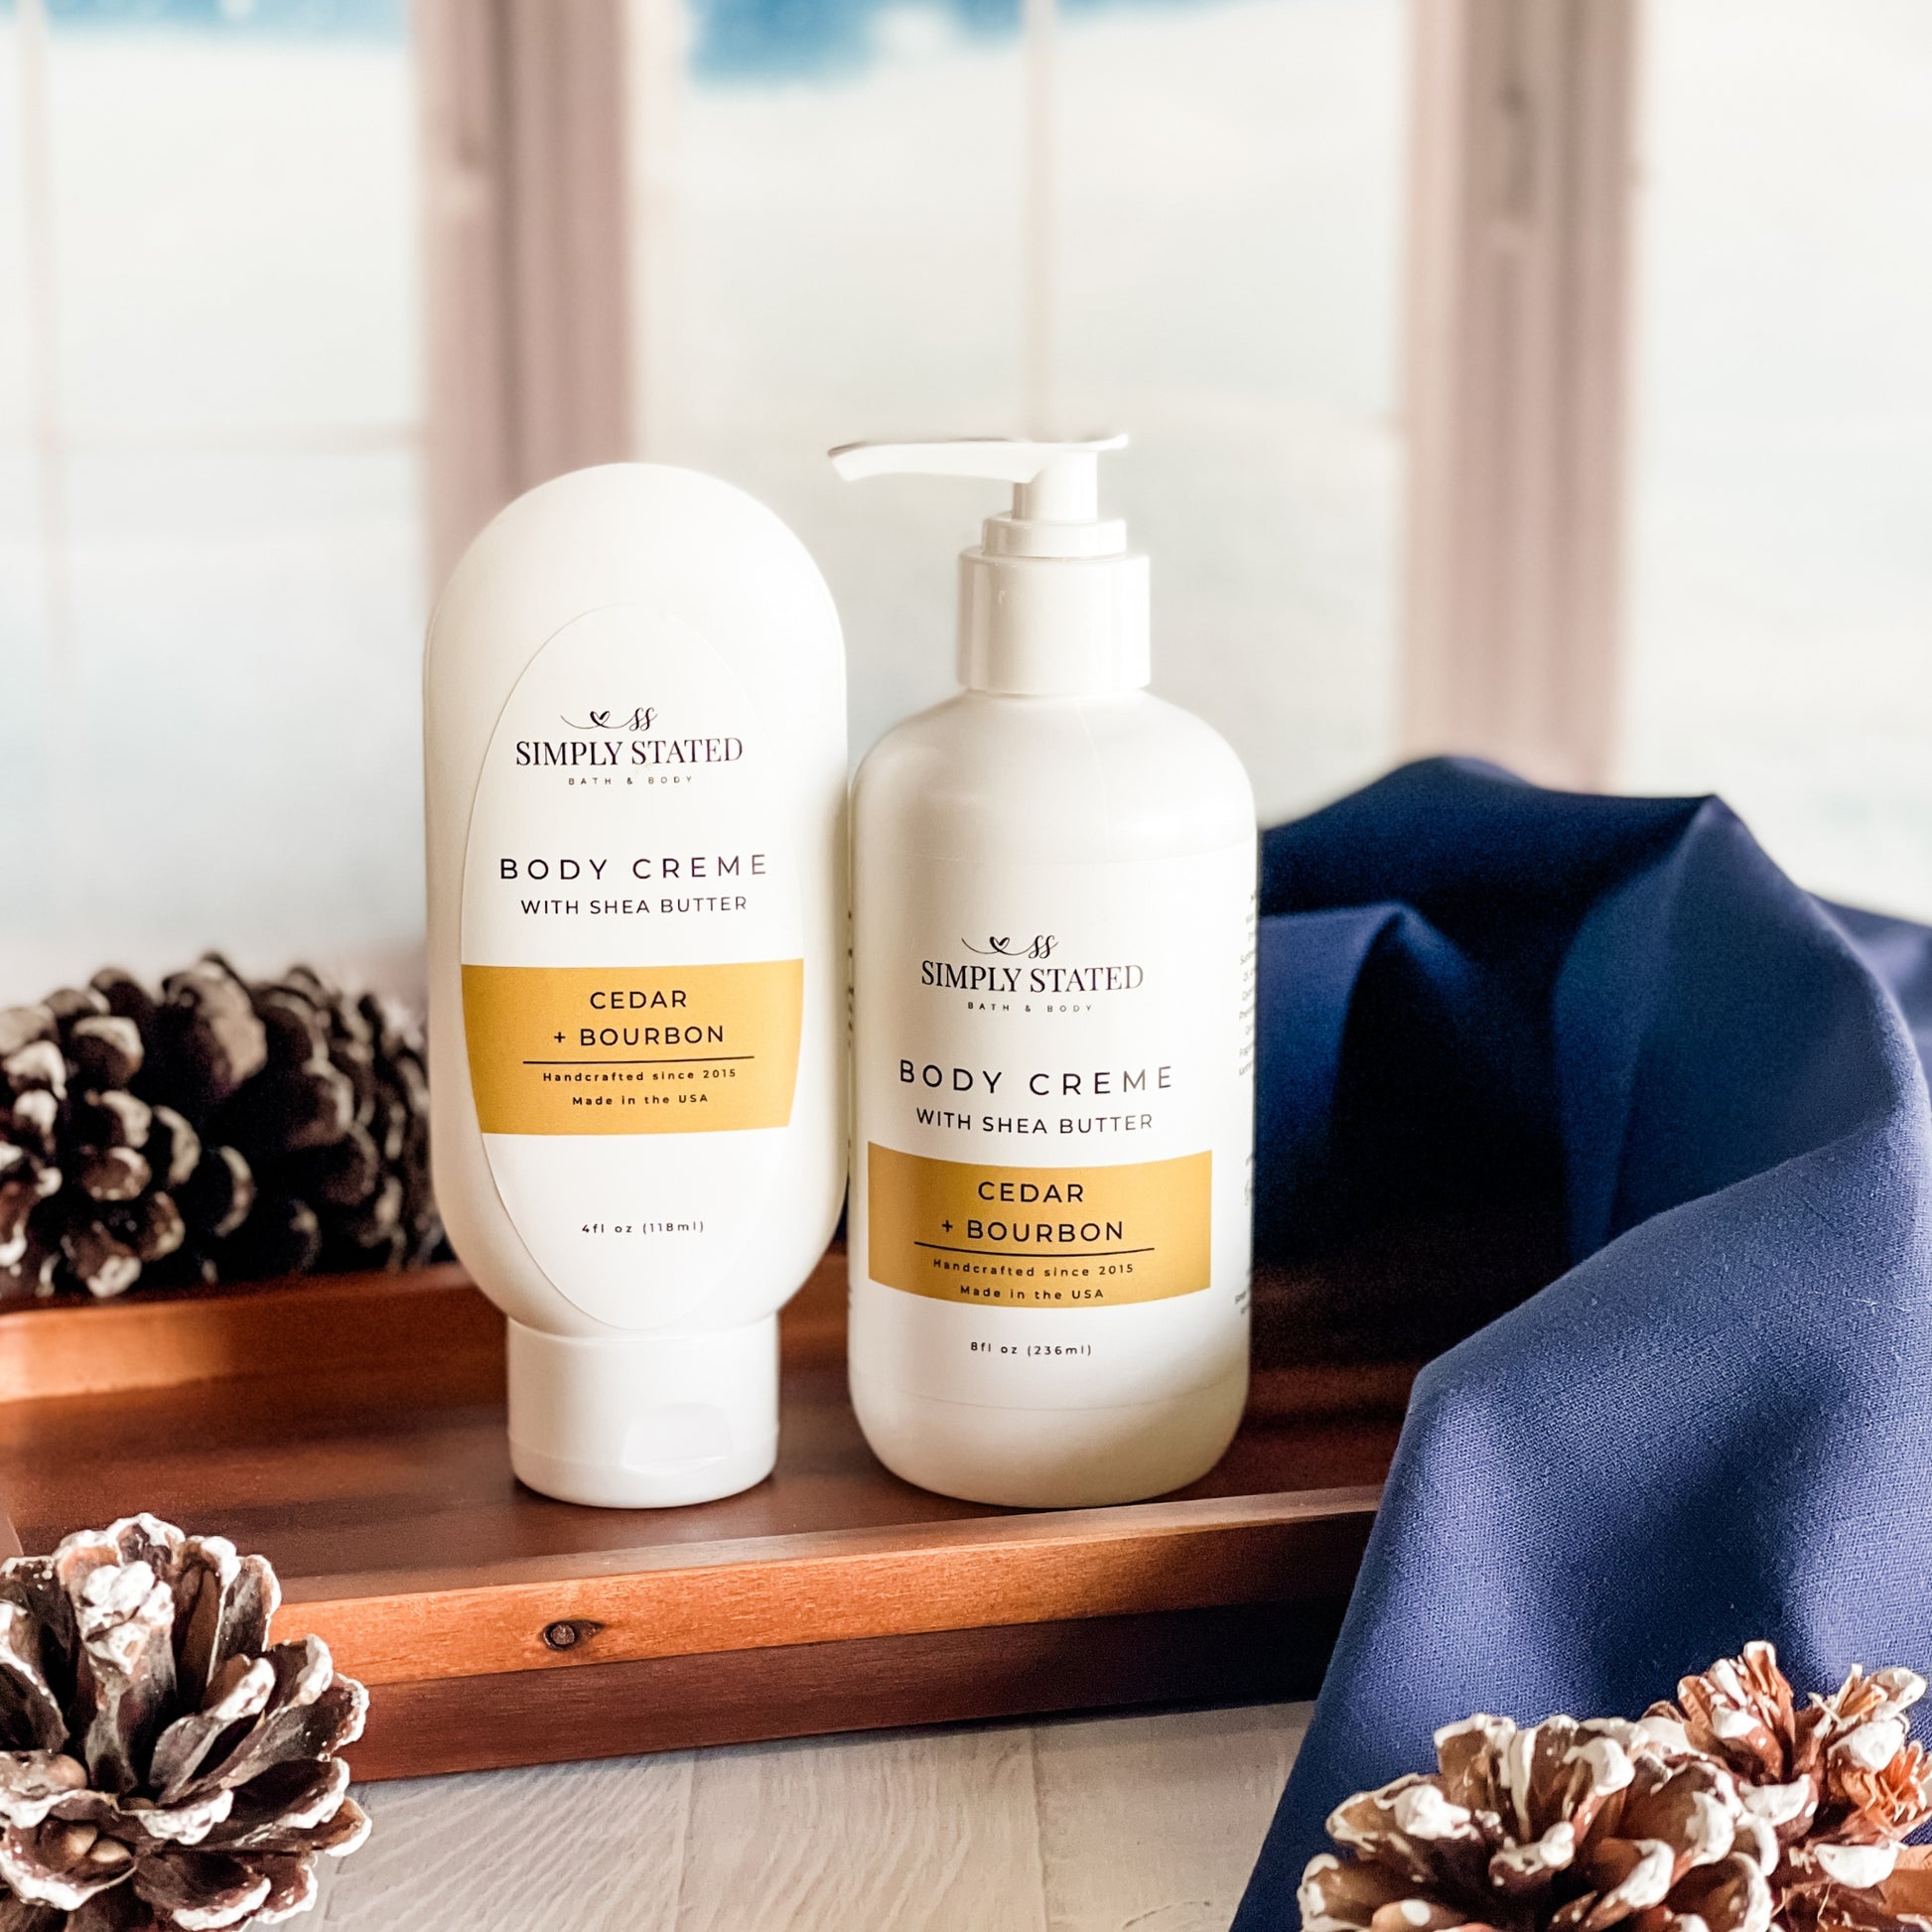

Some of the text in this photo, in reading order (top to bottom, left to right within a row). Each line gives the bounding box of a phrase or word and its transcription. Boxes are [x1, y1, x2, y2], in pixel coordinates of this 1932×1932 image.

[515, 738, 744, 765] SIMPLY STATED
[568, 775, 693, 786] BATH & BODY
[500, 855, 766, 881] BODY CREME
[520, 897, 747, 915] WITH SHEA BUTTER
[921, 960, 1145, 993] SIMPLY STATED
[590, 990, 687, 1011] CEDAR
[967, 1001, 1093, 1013] BATH & BODY
[554, 1026, 724, 1047] + BOURBON
[542, 1068, 737, 1082] Handcrafted since 2015
[900, 1059, 1173, 1096] BODY CREME
[572, 1093, 709, 1106] Made in the USA
[916, 1107, 1153, 1135] WITH SHEA BUTTER
[978, 1181, 1084, 1203] CEDAR
[582, 1220, 704, 1235] 4fl oz (118ml)
[941, 1219, 1123, 1244] + BOURBON
[933, 1258, 1134, 1278] Handcrafted since 2015
[960, 1285, 1104, 1301] Made in the USA
[970, 1341, 1092, 1357] 8fl oz (236ml)
